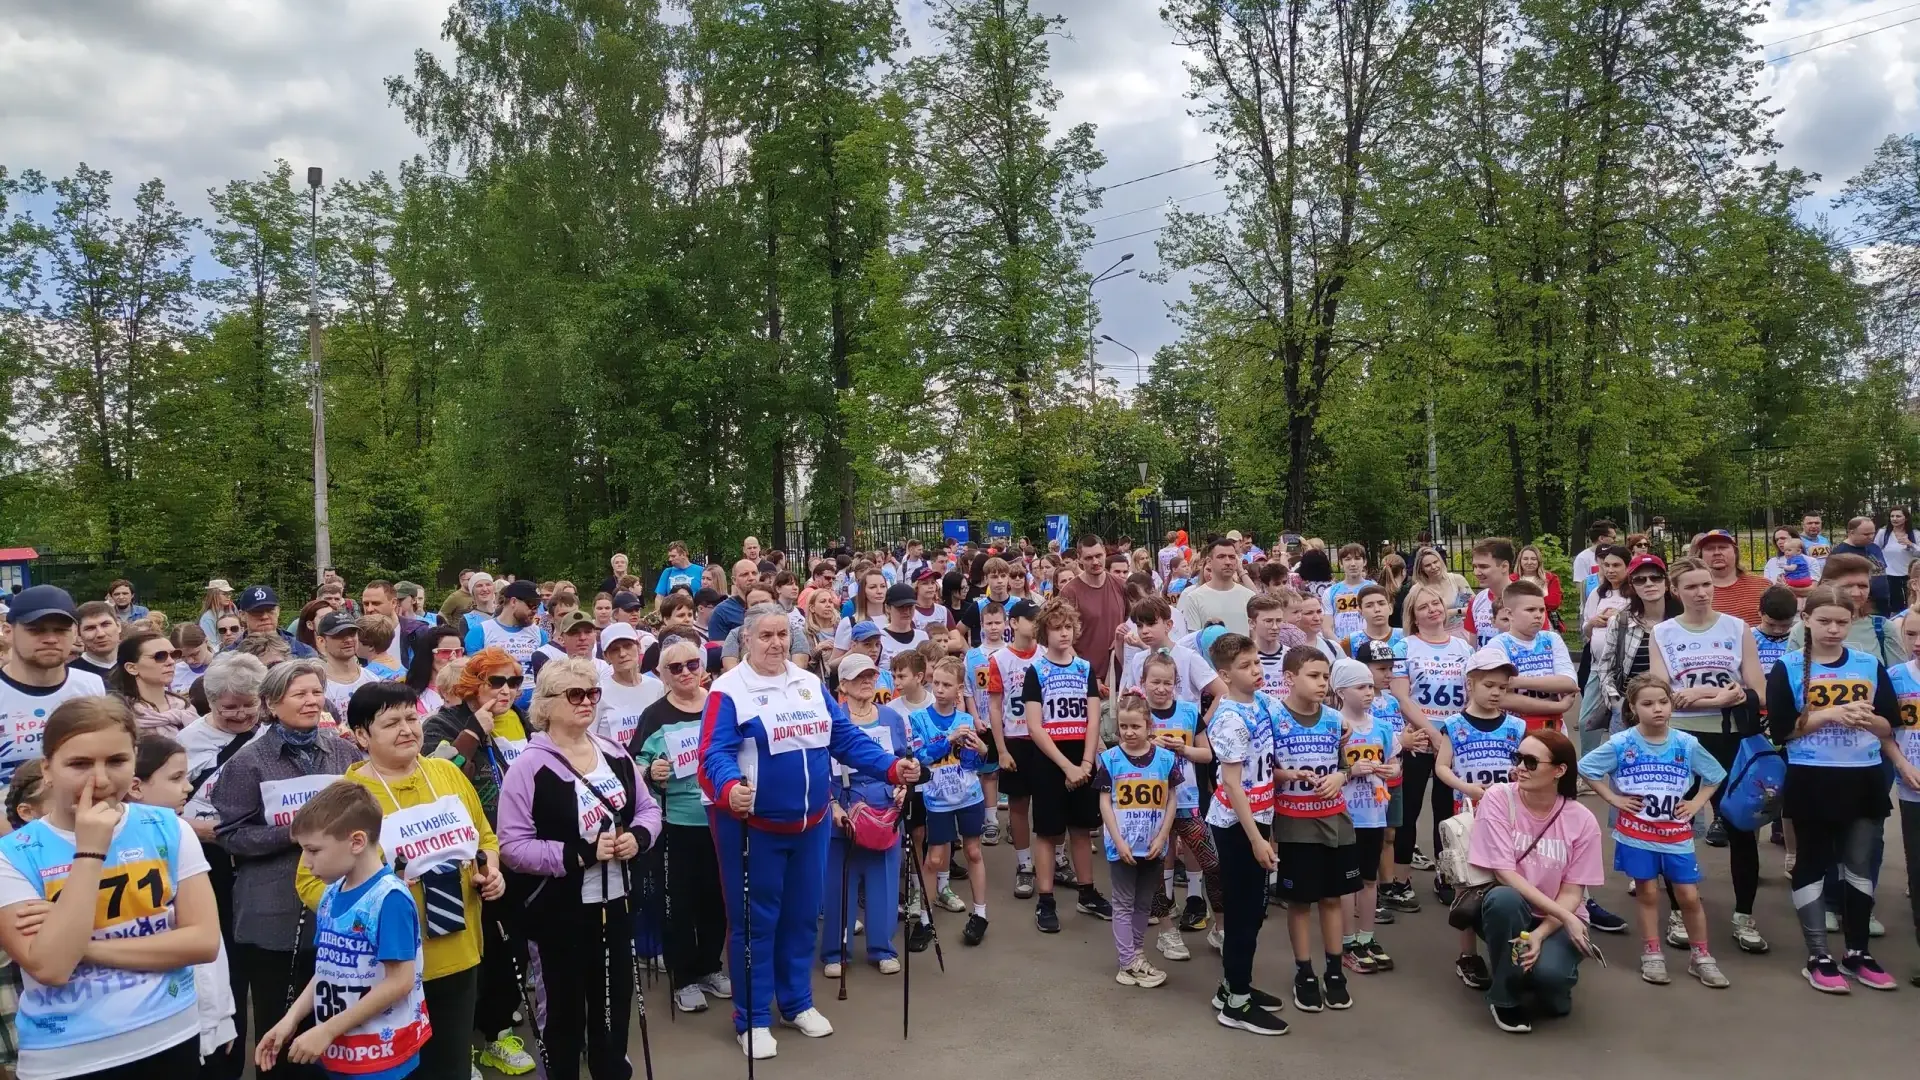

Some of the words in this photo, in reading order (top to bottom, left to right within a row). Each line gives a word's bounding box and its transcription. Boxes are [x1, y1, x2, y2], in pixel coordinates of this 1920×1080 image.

[1337, 597, 1358, 610] 34
[1418, 684, 1465, 706] 365
[1809, 684, 1869, 707] 328
[776, 710, 819, 722] АКТИВНОЕ
[773, 720, 829, 742] ДОЛГОЛЕТИЕ
[1290, 744, 1333, 754] МОРОЗЫ
[1467, 750, 1511, 760] МОРОЗЫ
[1622, 764, 1688, 776] КРЕЩЕНСКИЕ
[1118, 783, 1163, 806] 360
[400, 811, 460, 838] АКТИВНОЕ
[395, 826, 476, 860] ДОЛГОЛЕТИЕ
[316, 946, 356, 965] ОРОЗЫ
[326, 1042, 394, 1062] ОГОРСК
